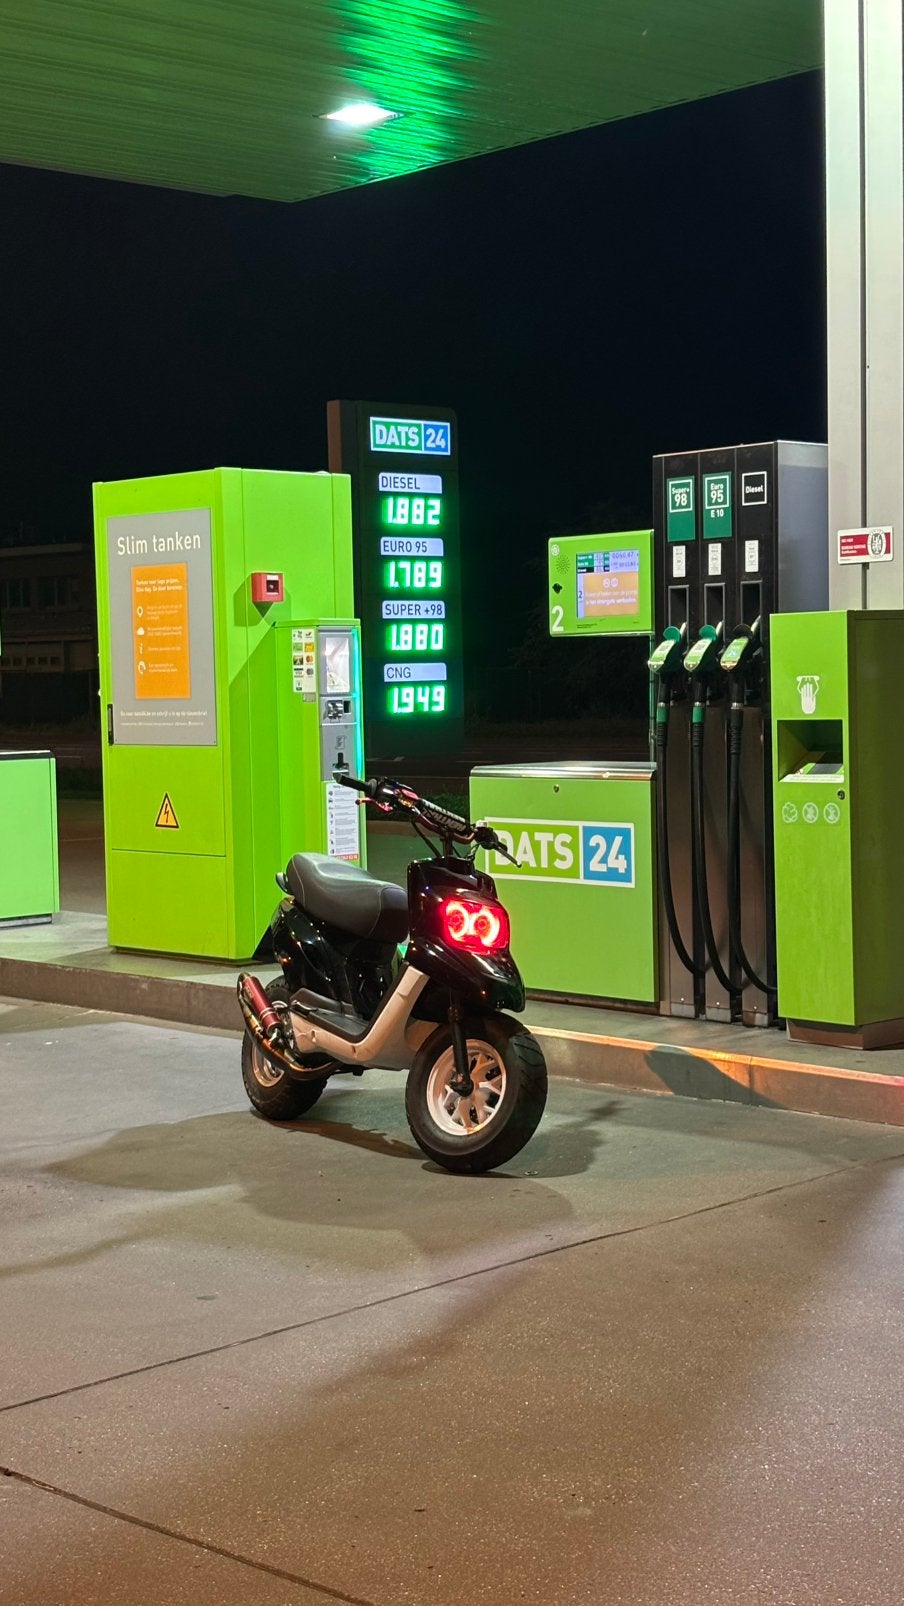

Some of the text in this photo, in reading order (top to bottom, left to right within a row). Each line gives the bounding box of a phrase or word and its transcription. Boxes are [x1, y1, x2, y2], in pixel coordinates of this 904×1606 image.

[375, 427, 446, 449] DATS 24
[381, 476, 421, 490] DIESEL
[745, 485, 764, 494] Diesel
[674, 494, 688, 507] 98
[710, 489, 724, 503] 95
[386, 498, 441, 525] 1.882
[710, 508, 724, 518] E 10
[117, 531, 202, 556] Slim tanken
[383, 540, 427, 553] EURO 95
[389, 561, 442, 588] 1.789
[385, 603, 443, 616] SUPER +98
[551, 605, 564, 632] 2
[390, 624, 444, 651] 1.880
[386, 666, 412, 679] CNG
[393, 686, 445, 714] 1.949
[495, 829, 628, 874] DATS 24
